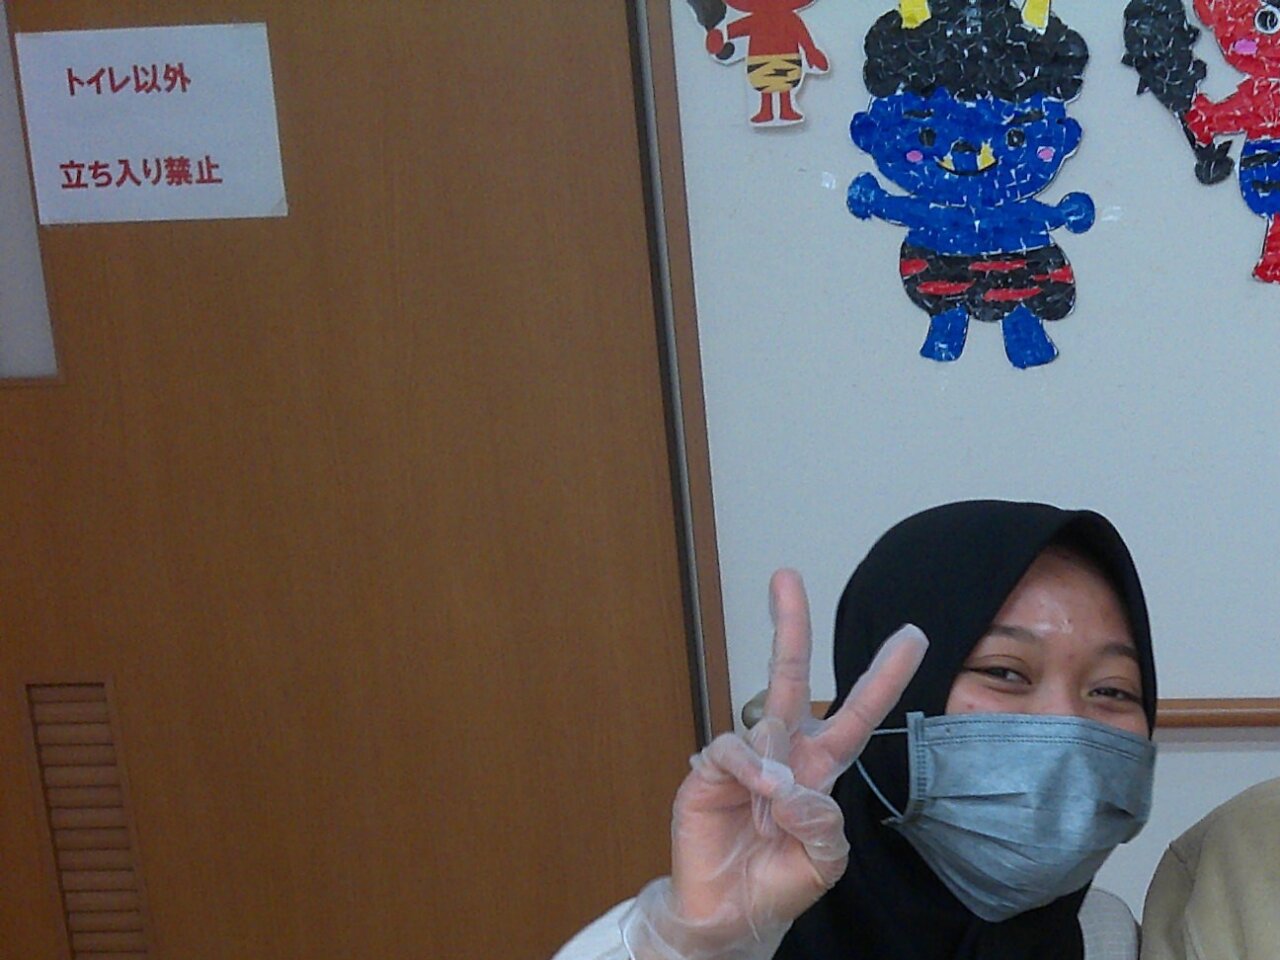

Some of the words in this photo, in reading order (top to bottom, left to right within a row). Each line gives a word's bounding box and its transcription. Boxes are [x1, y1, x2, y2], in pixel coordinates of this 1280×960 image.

[66, 62, 192, 96] トイレ以外
[59, 155, 223, 189] 立ち入り禁止
